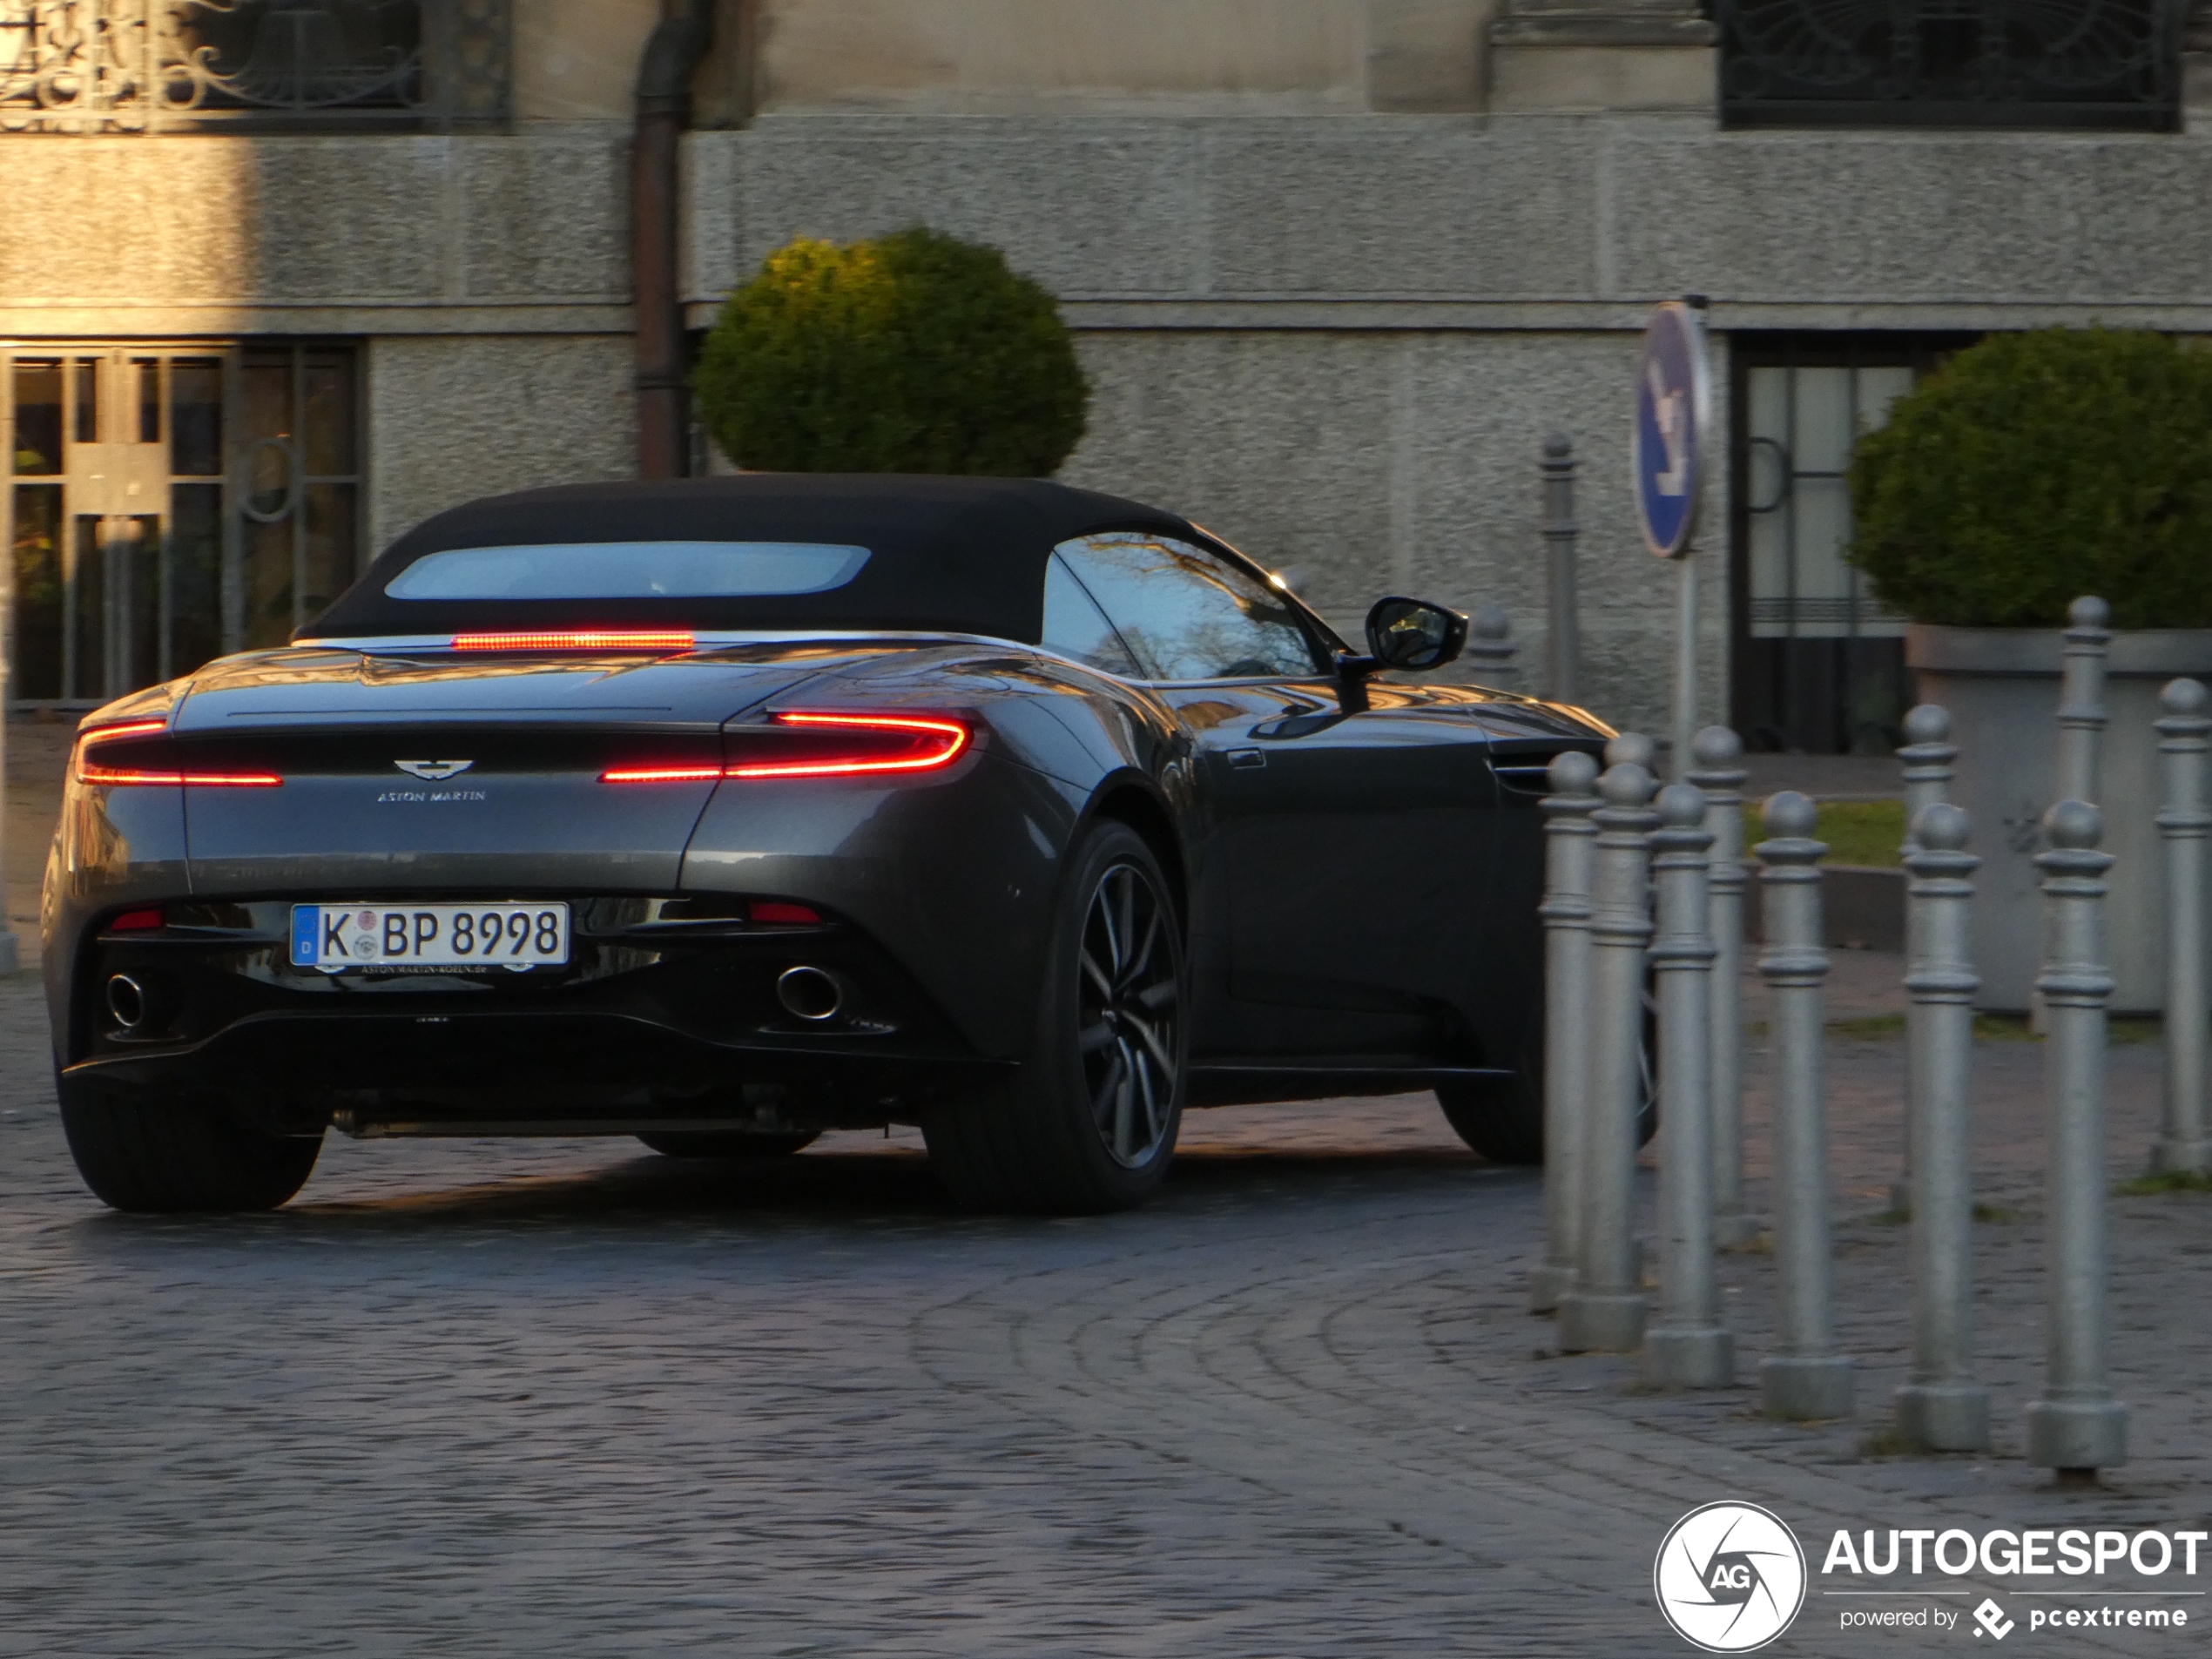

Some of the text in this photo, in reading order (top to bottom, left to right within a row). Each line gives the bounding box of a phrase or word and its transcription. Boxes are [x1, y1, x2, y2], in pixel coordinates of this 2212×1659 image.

[377, 791, 486, 802] ASTON MARTIN
[323, 911, 558, 956] K BP 8998
[301, 942, 311, 954] D
[361, 965, 395, 974] ASTON
